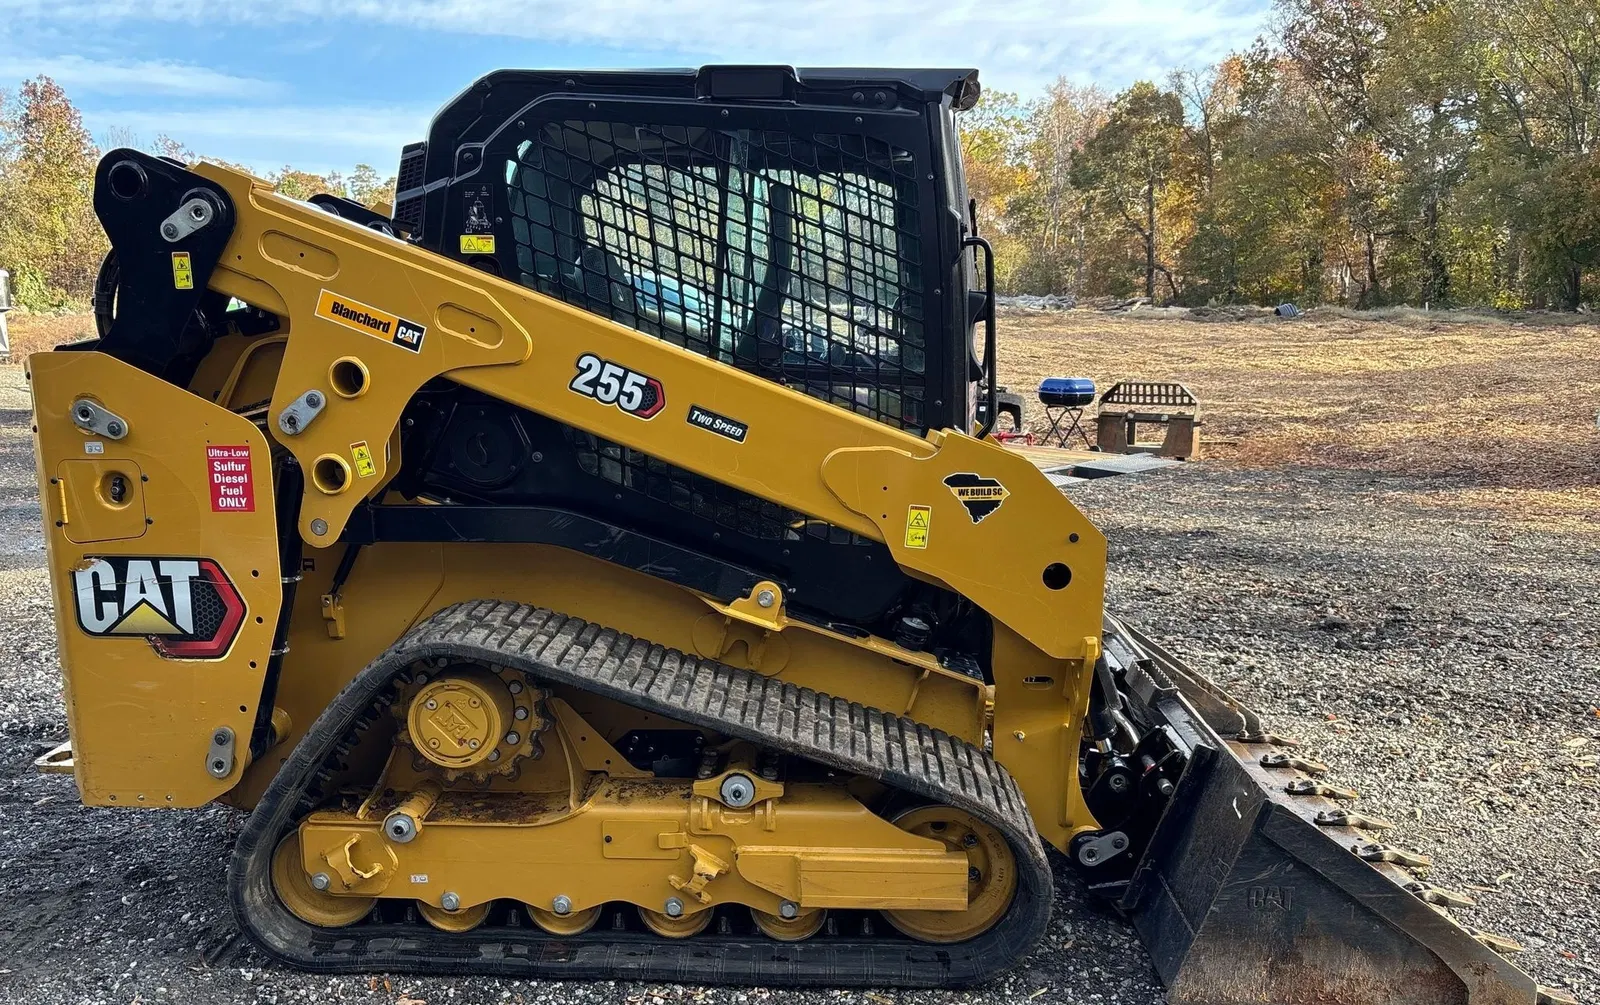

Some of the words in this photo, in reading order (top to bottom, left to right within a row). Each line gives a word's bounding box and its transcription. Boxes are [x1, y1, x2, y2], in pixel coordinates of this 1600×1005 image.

[331, 301, 391, 333] Blanchard
[397, 326, 420, 345] CAT
[571, 355, 647, 411] 255
[692, 410, 713, 426] TWO
[713, 417, 743, 437] SPEED
[208, 448, 249, 457] Ultra-Low
[213, 461, 246, 471] Sulfur
[213, 473, 248, 483] Diesel
[220, 485, 243, 495] Fuel
[958, 488, 970, 497] WE
[970, 488, 992, 497] BUILD
[992, 487, 1003, 496] SC
[218, 497, 247, 507] ONLY
[75, 559, 200, 635] CAT
[1247, 885, 1296, 911] CAT
